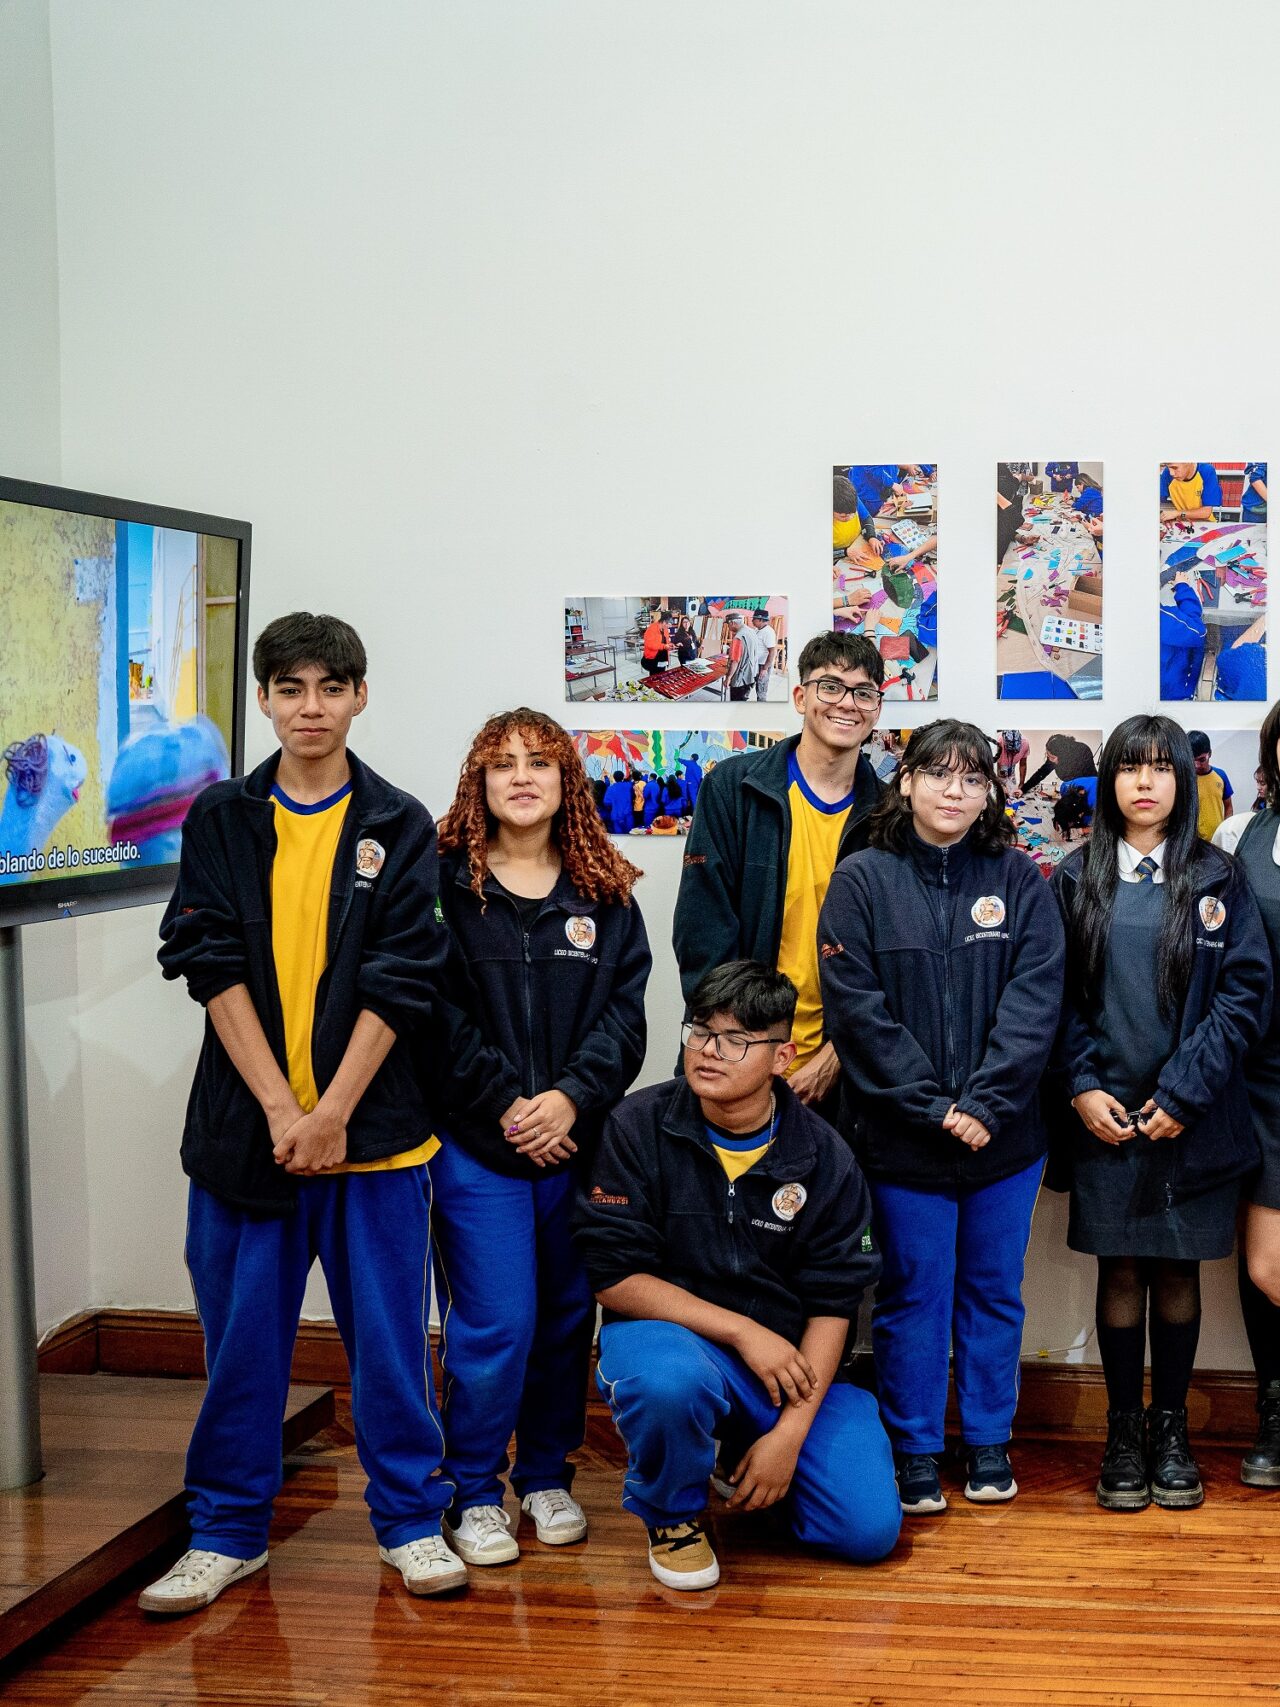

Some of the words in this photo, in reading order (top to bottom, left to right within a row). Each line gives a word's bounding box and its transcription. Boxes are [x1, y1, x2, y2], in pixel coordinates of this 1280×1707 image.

[47, 847, 65, 869] de
[67, 845, 79, 866] lo
[82, 841, 141, 865] sucedido.
